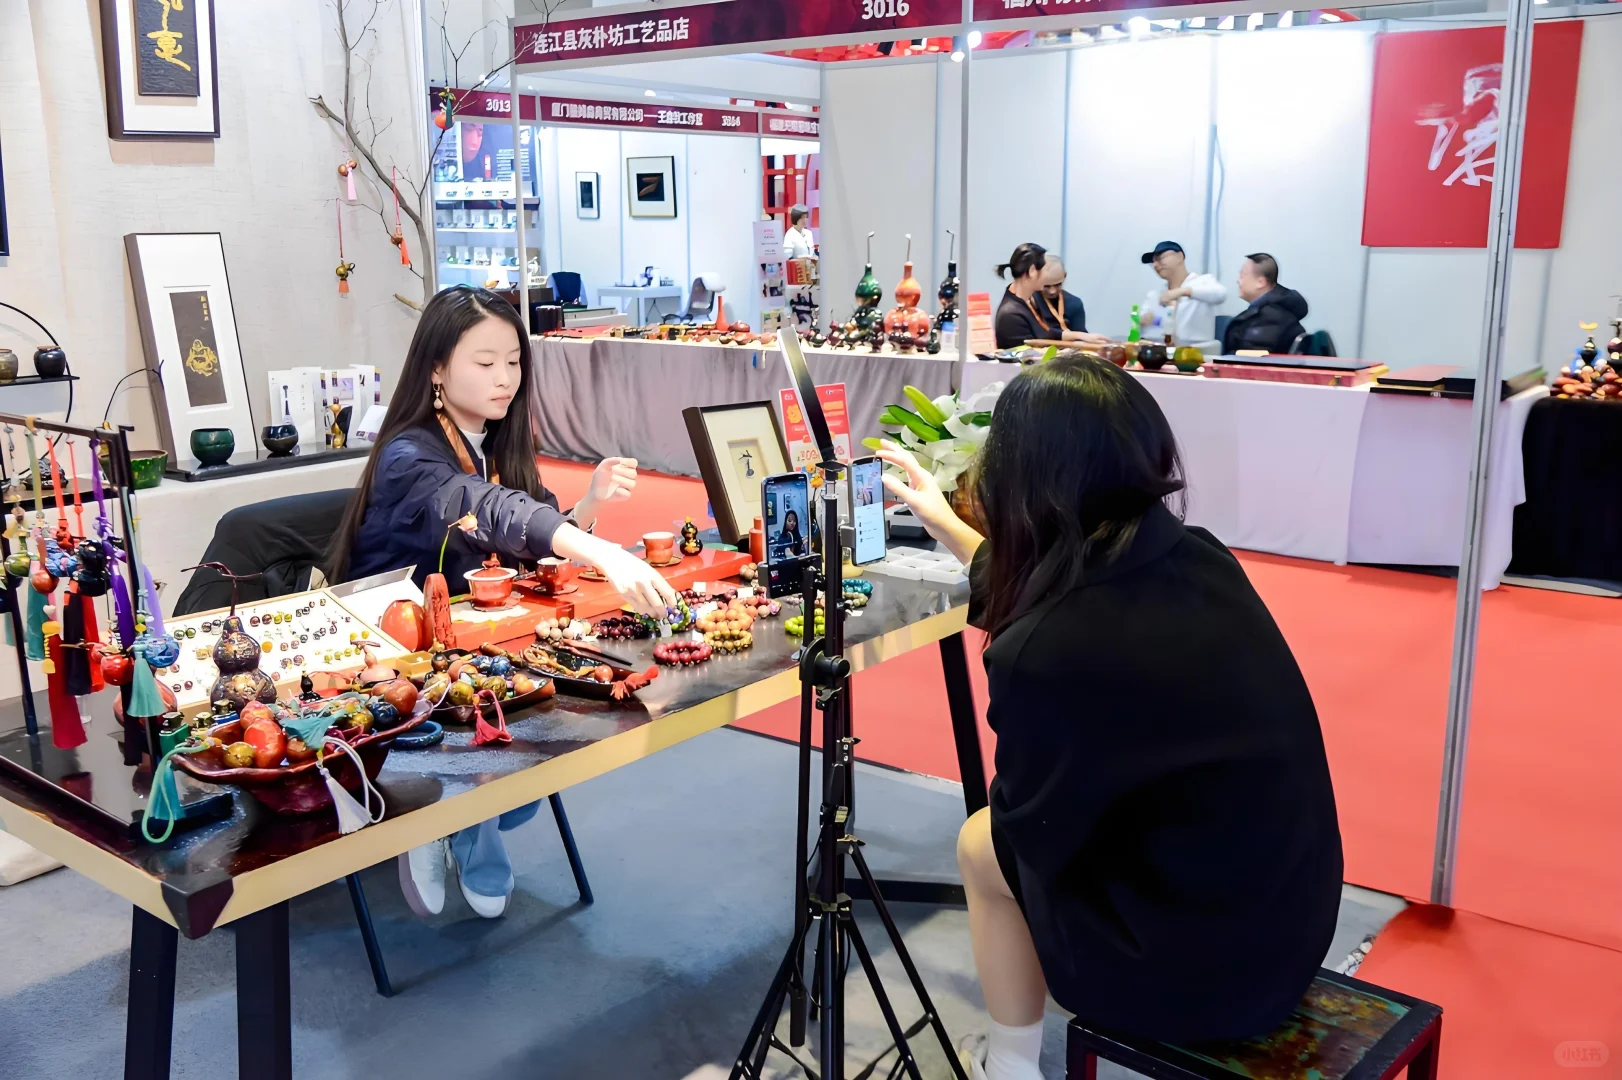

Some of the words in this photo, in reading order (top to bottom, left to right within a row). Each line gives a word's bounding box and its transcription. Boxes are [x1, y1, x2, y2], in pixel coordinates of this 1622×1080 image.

[861, 0, 910, 20] 3016
[533, 16, 690, 55] 连江县灰朴坊工艺品店
[485, 98, 512, 113] 3013
